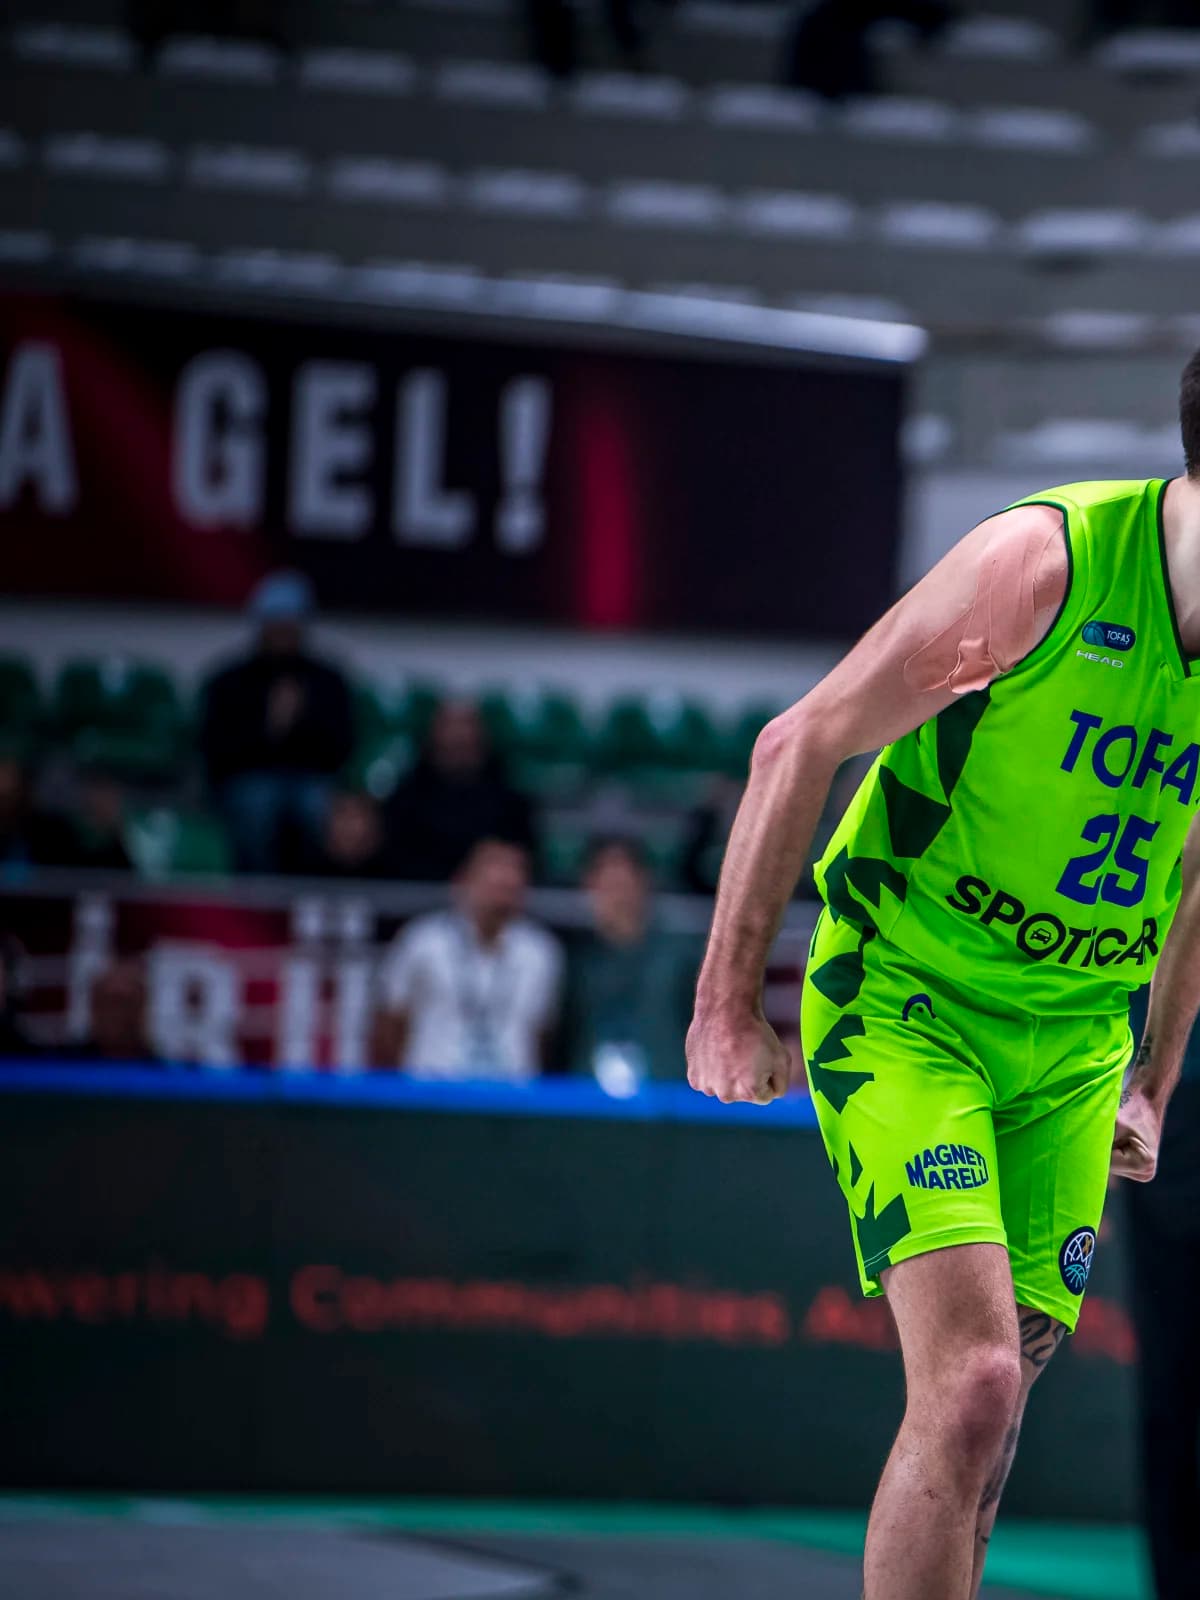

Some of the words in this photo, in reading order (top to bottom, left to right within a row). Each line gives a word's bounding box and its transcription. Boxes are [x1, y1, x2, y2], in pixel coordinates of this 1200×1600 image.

[171, 347, 554, 554] GEL!
[1076, 649, 1124, 669] HEAD
[1055, 813, 1161, 908] 25
[945, 874, 1159, 968] SPOTICAR
